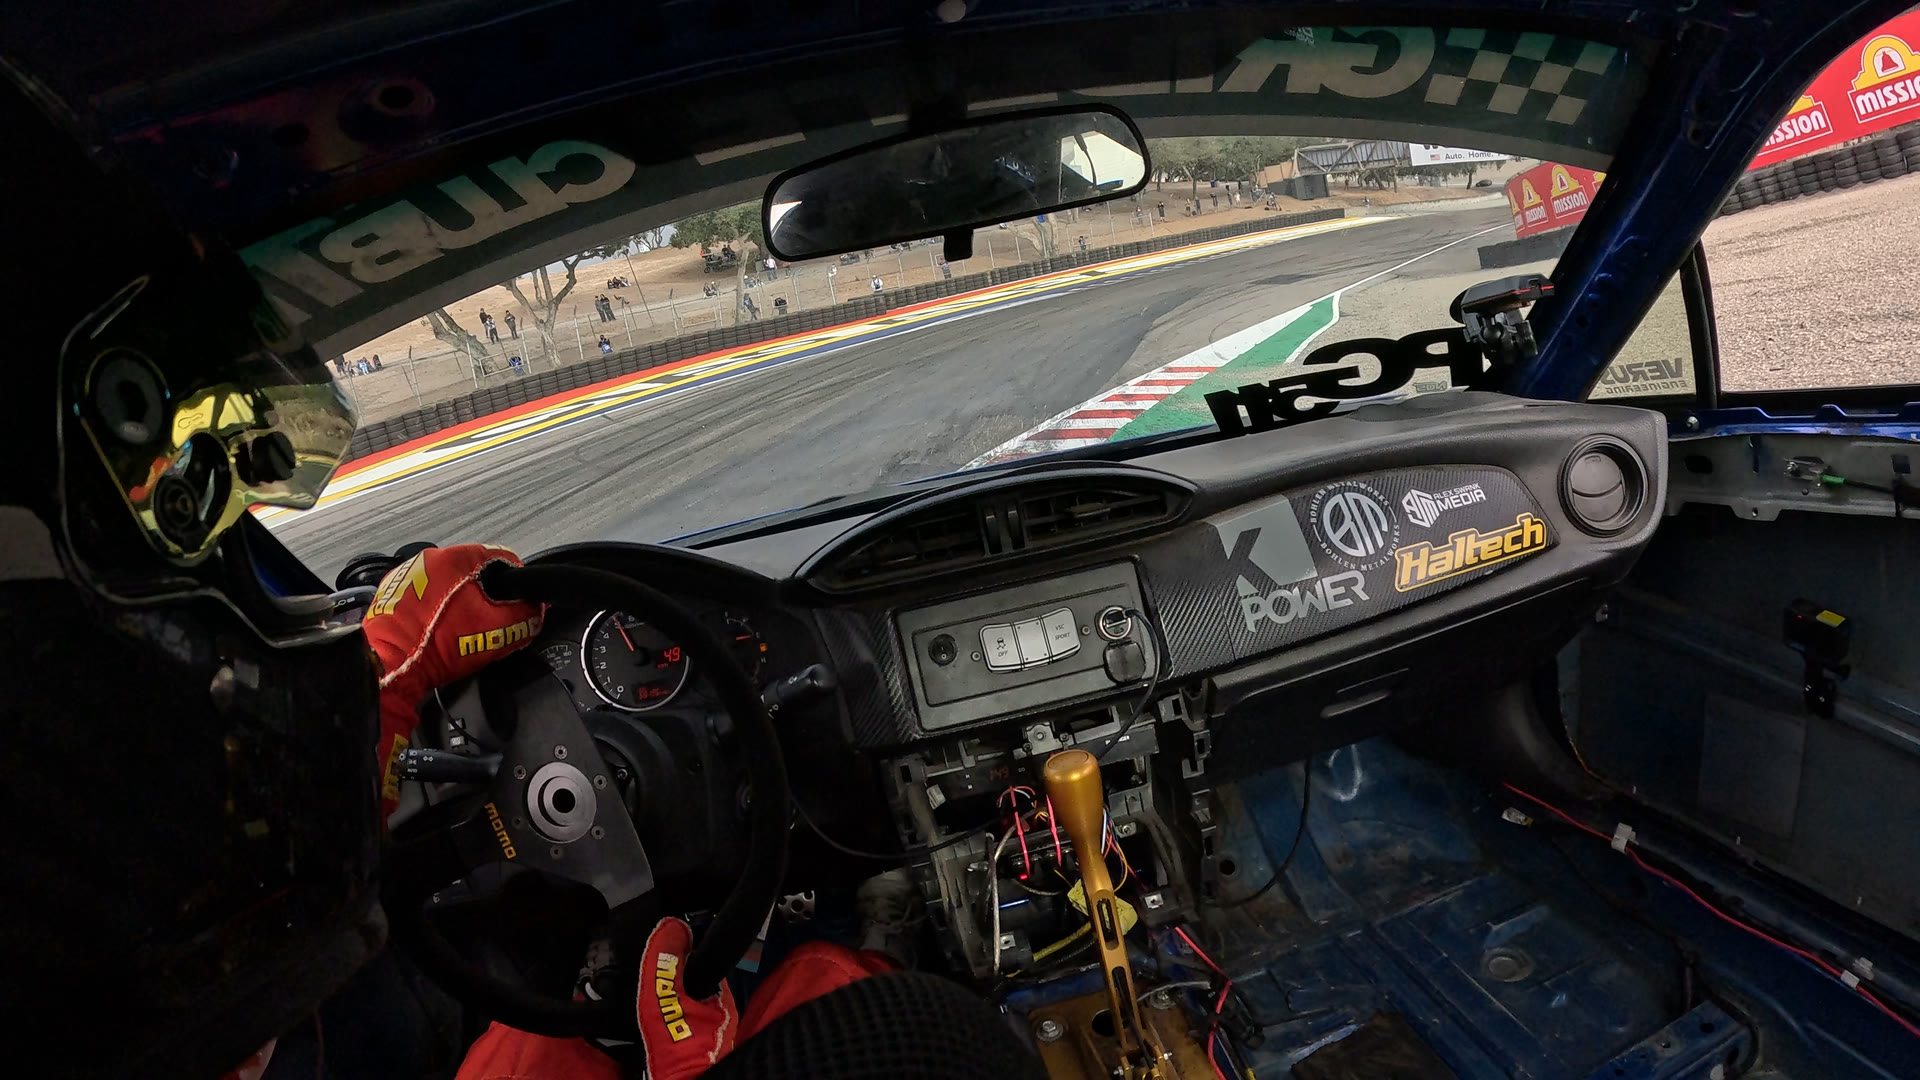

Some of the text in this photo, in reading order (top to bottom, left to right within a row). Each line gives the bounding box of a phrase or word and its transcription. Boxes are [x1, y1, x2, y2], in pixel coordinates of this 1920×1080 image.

[1765, 110, 1827, 147] ISSION
[1553, 190, 1587, 214] MISSION
[1310, 480, 1390, 523] BOHLEN METALWORKS
[1433, 482, 1481, 500] ALEX SWANK
[1436, 488, 1487, 512] MEDIA
[1319, 524, 1400, 572] BOHLEN METALWORKS
[1399, 516, 1545, 588] Haltech
[1240, 570, 1371, 633] POWER
[1054, 631, 1071, 641] SPORT
[600, 646, 607, 654] 3
[663, 646, 681, 662] 49
[599, 662, 607, 670] 2
[617, 685, 624, 693] 0
